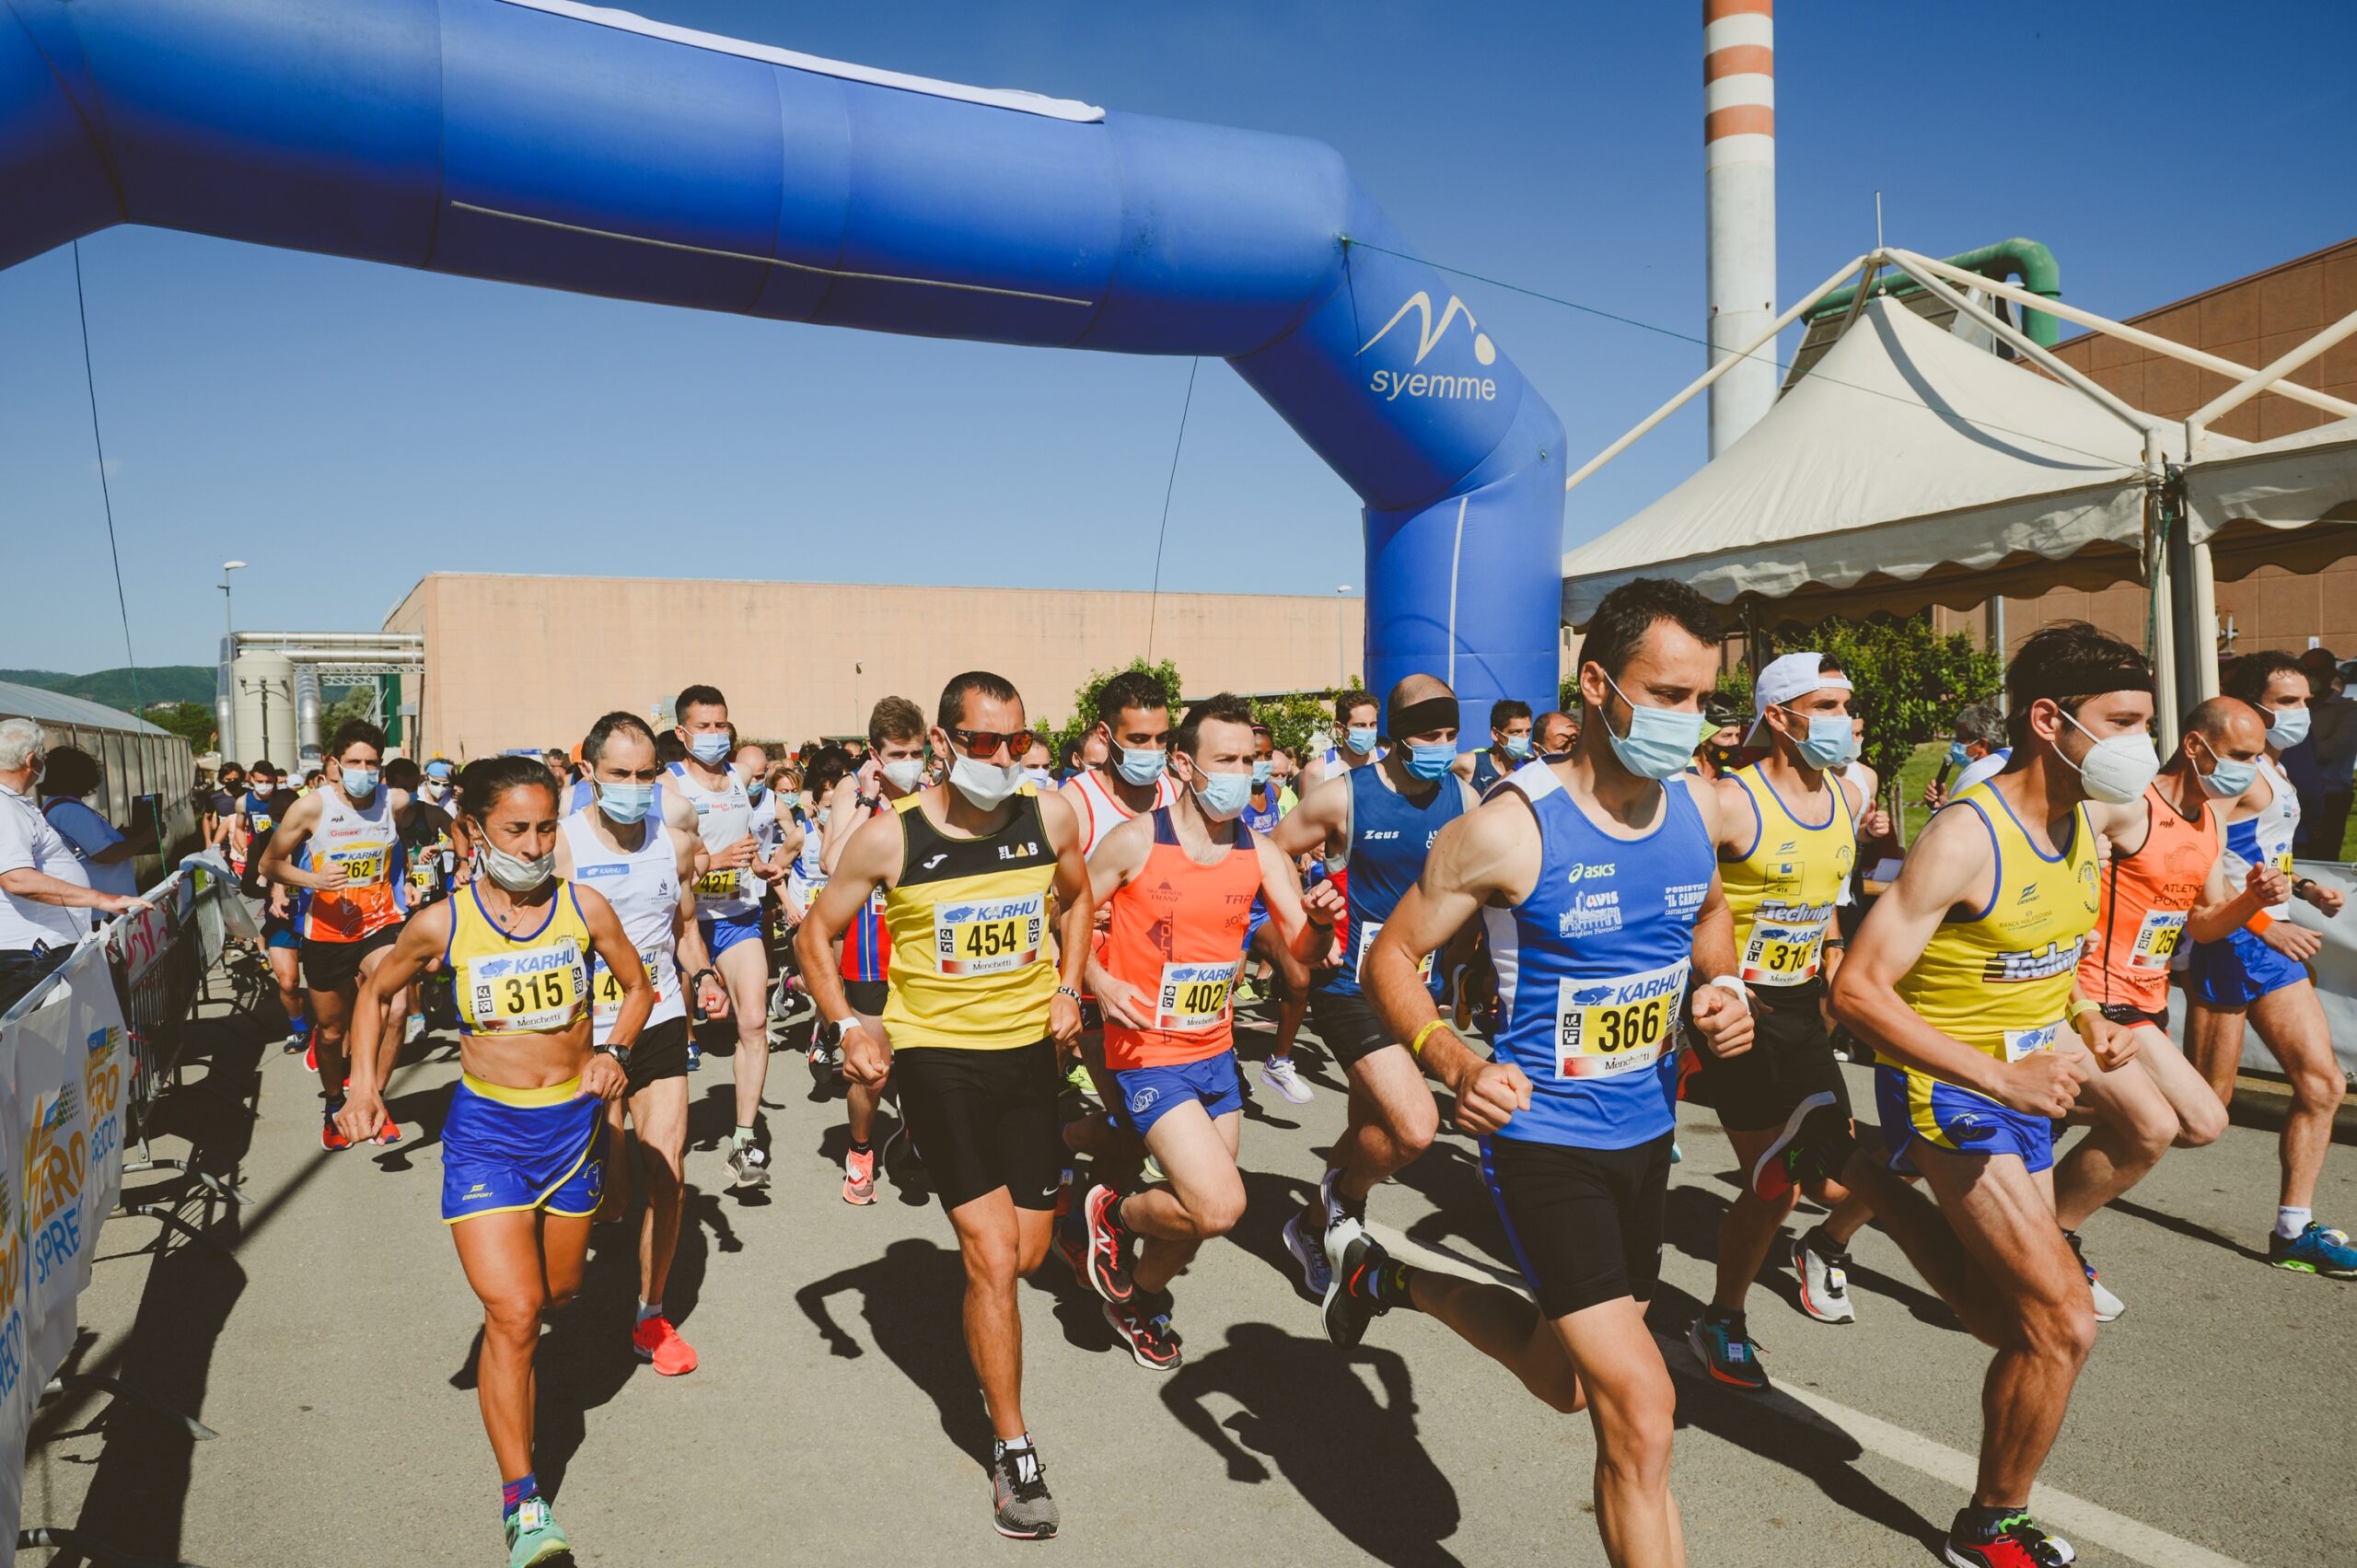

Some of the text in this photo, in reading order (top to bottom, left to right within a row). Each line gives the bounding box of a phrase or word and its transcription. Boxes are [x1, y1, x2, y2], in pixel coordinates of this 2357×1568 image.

[1370, 370, 1496, 401] syemme
[1364, 830, 1399, 840] Zeus
[348, 850, 382, 861] KARHU
[1584, 863, 1616, 878] asics
[702, 874, 729, 893] 427
[2162, 883, 2202, 893] ATLETIC
[977, 900, 1038, 921] KARHU
[2153, 895, 2195, 907] PONTIC
[967, 921, 1016, 957] 454
[2154, 929, 2177, 954] 25
[515, 947, 575, 974] KARHU
[972, 958, 1011, 970] Menchetti
[1196, 967, 1237, 981] KARHU
[505, 972, 563, 1014] 315
[1616, 970, 1684, 1005] KARHU
[1185, 983, 1224, 1014] 402
[517, 1014, 561, 1027] Menchetti
[1598, 1001, 1660, 1052] 366
[30, 1130, 86, 1233] ZERO
